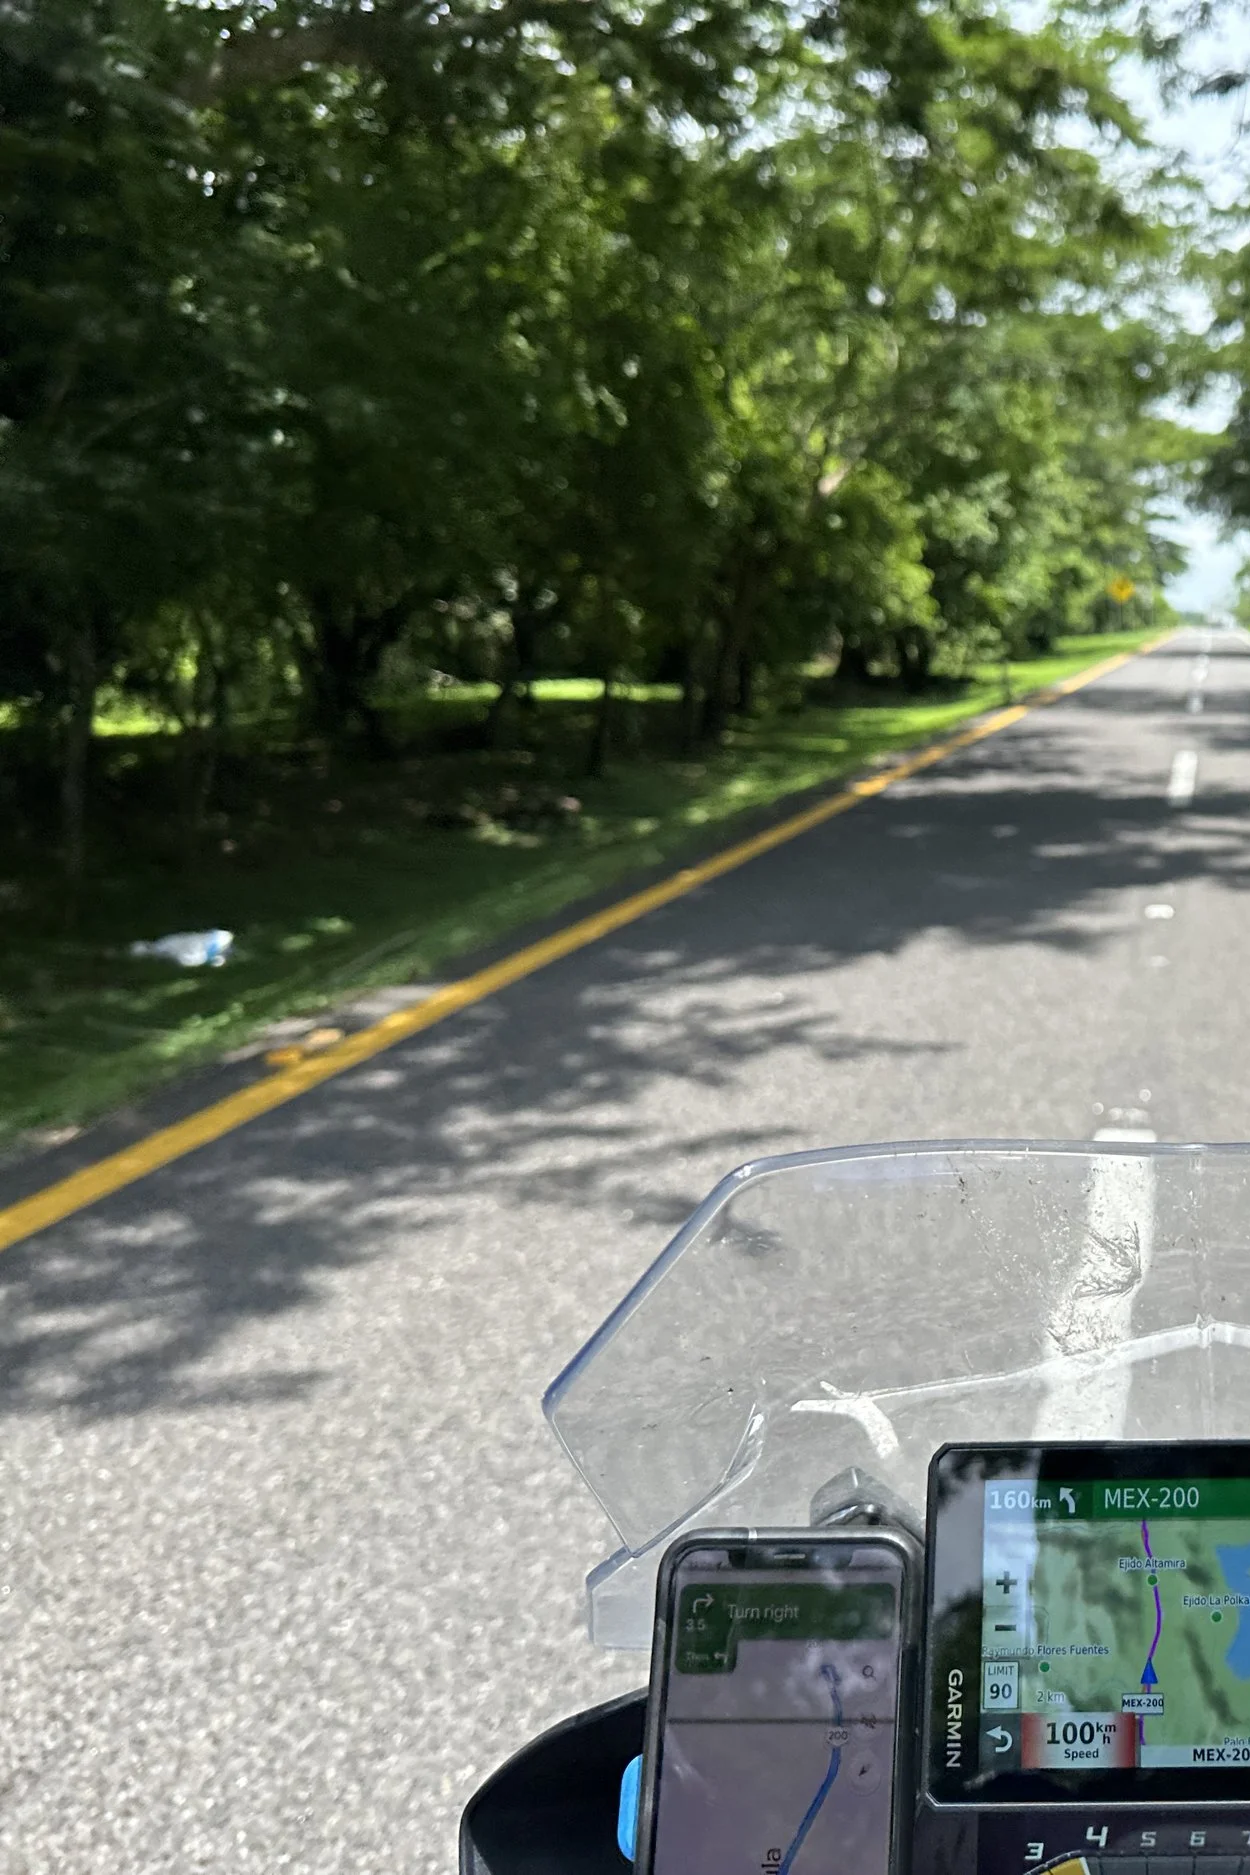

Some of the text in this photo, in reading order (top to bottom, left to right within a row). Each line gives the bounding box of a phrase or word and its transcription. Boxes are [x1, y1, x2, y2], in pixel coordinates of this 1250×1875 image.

[1104, 1487, 1200, 1508] MEX-200
[1119, 1558, 1186, 1570] Ejido Altamira
[1183, 1595, 1250, 1607] Ejido La Polka
[728, 1604, 800, 1622] Turn right
[1037, 1644, 1067, 1656] Flores
[1069, 1644, 1110, 1656] Fuentes
[988, 1665, 1014, 1676] LIMIT
[989, 1683, 1013, 1699] 90
[1047, 1691, 1065, 1702] km
[1122, 1698, 1164, 1708] MEX-200
[946, 1668, 964, 1768] GARMIN
[828, 1731, 849, 1740] 200
[1046, 1722, 1095, 1745] 100
[1064, 1747, 1099, 1761] Speed
[1025, 1842, 1044, 1860] 3
[1086, 1826, 1108, 1847] 4
[1140, 1831, 1157, 1847] 5
[1189, 1830, 1206, 1847] 6
